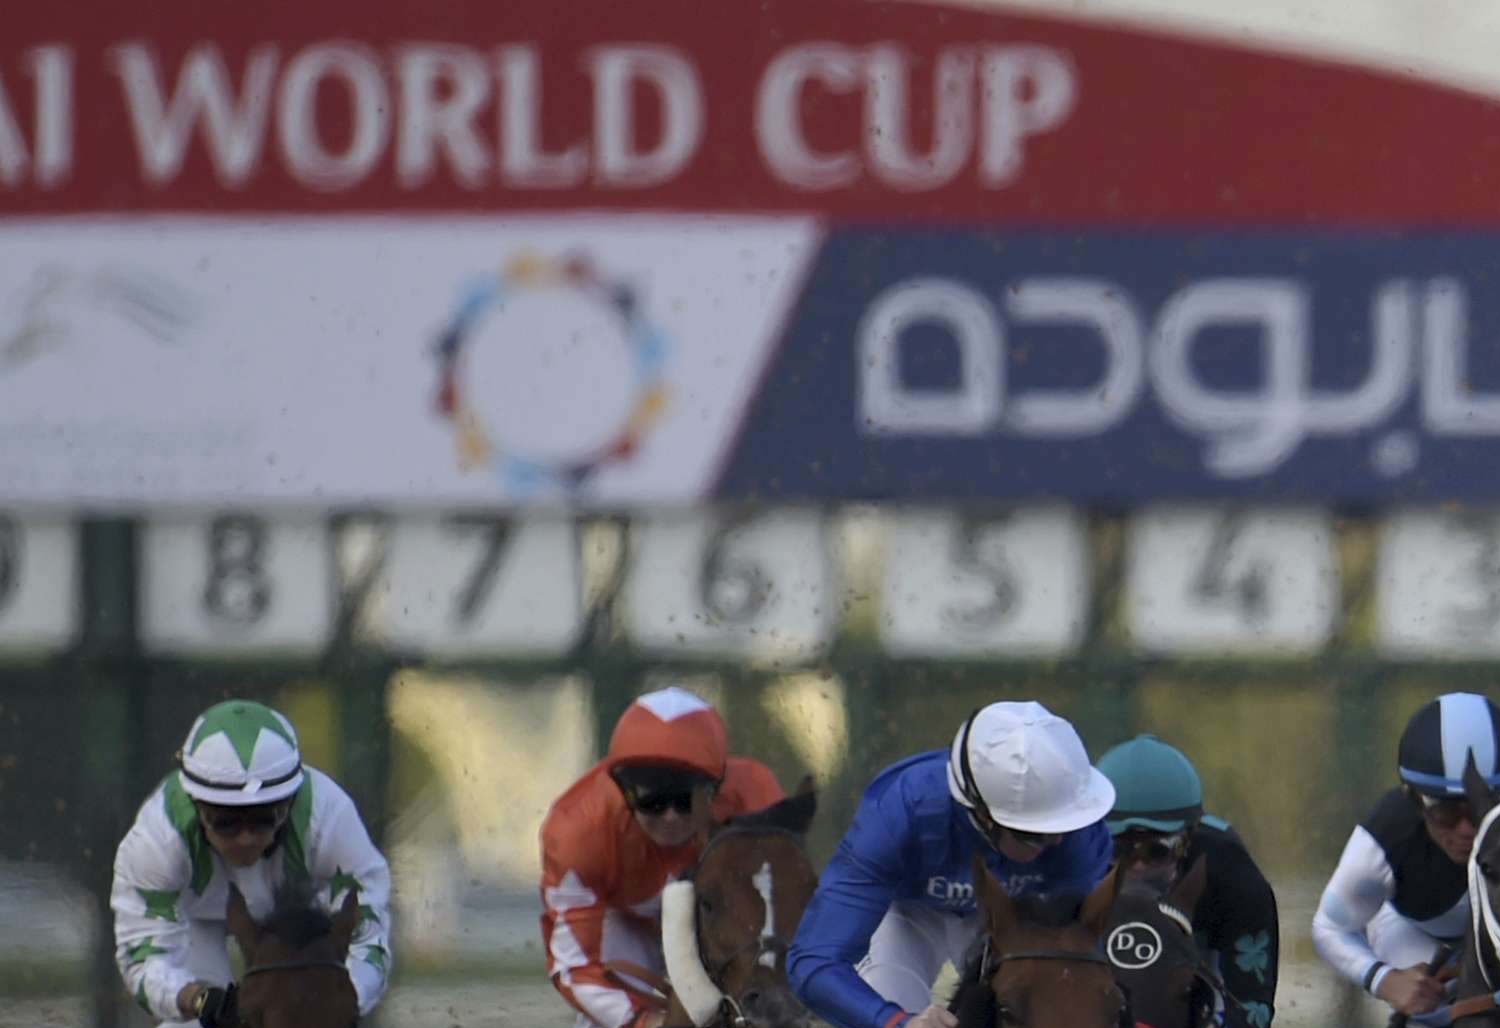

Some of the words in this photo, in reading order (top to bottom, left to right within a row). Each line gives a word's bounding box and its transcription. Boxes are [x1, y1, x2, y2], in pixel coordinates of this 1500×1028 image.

[110, 44, 705, 188] WORLD
[755, 44, 1075, 188] CUP
[203, 515, 270, 622] 8
[440, 513, 512, 622] 7
[700, 512, 768, 622] 6
[945, 515, 1016, 625] 5
[1190, 513, 1270, 628] 4
[1117, 933, 1134, 950] D
[1135, 944, 1154, 960] O
